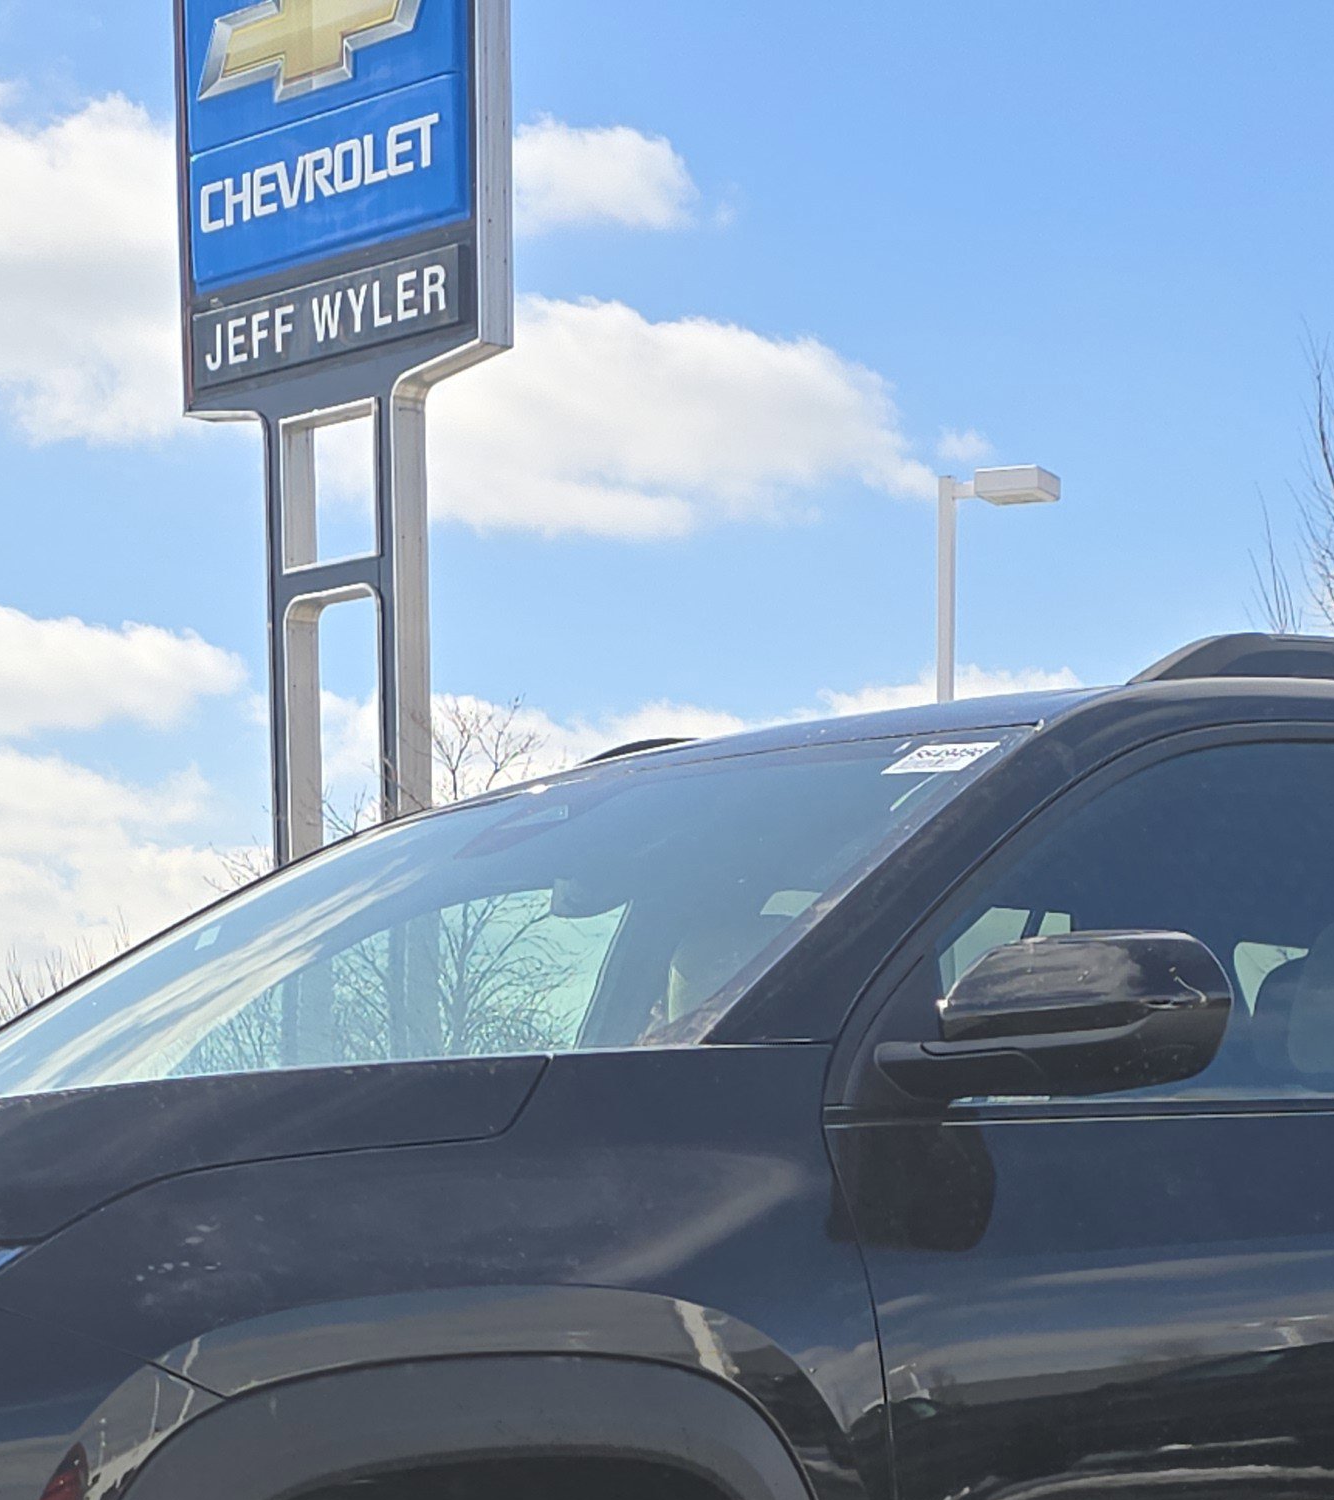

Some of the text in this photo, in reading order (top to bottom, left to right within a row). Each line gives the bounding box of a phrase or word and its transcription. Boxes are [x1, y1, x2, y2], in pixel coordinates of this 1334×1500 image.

[200, 112, 439, 233] CHEVROLET
[205, 264, 447, 372] JEFF WYLER
